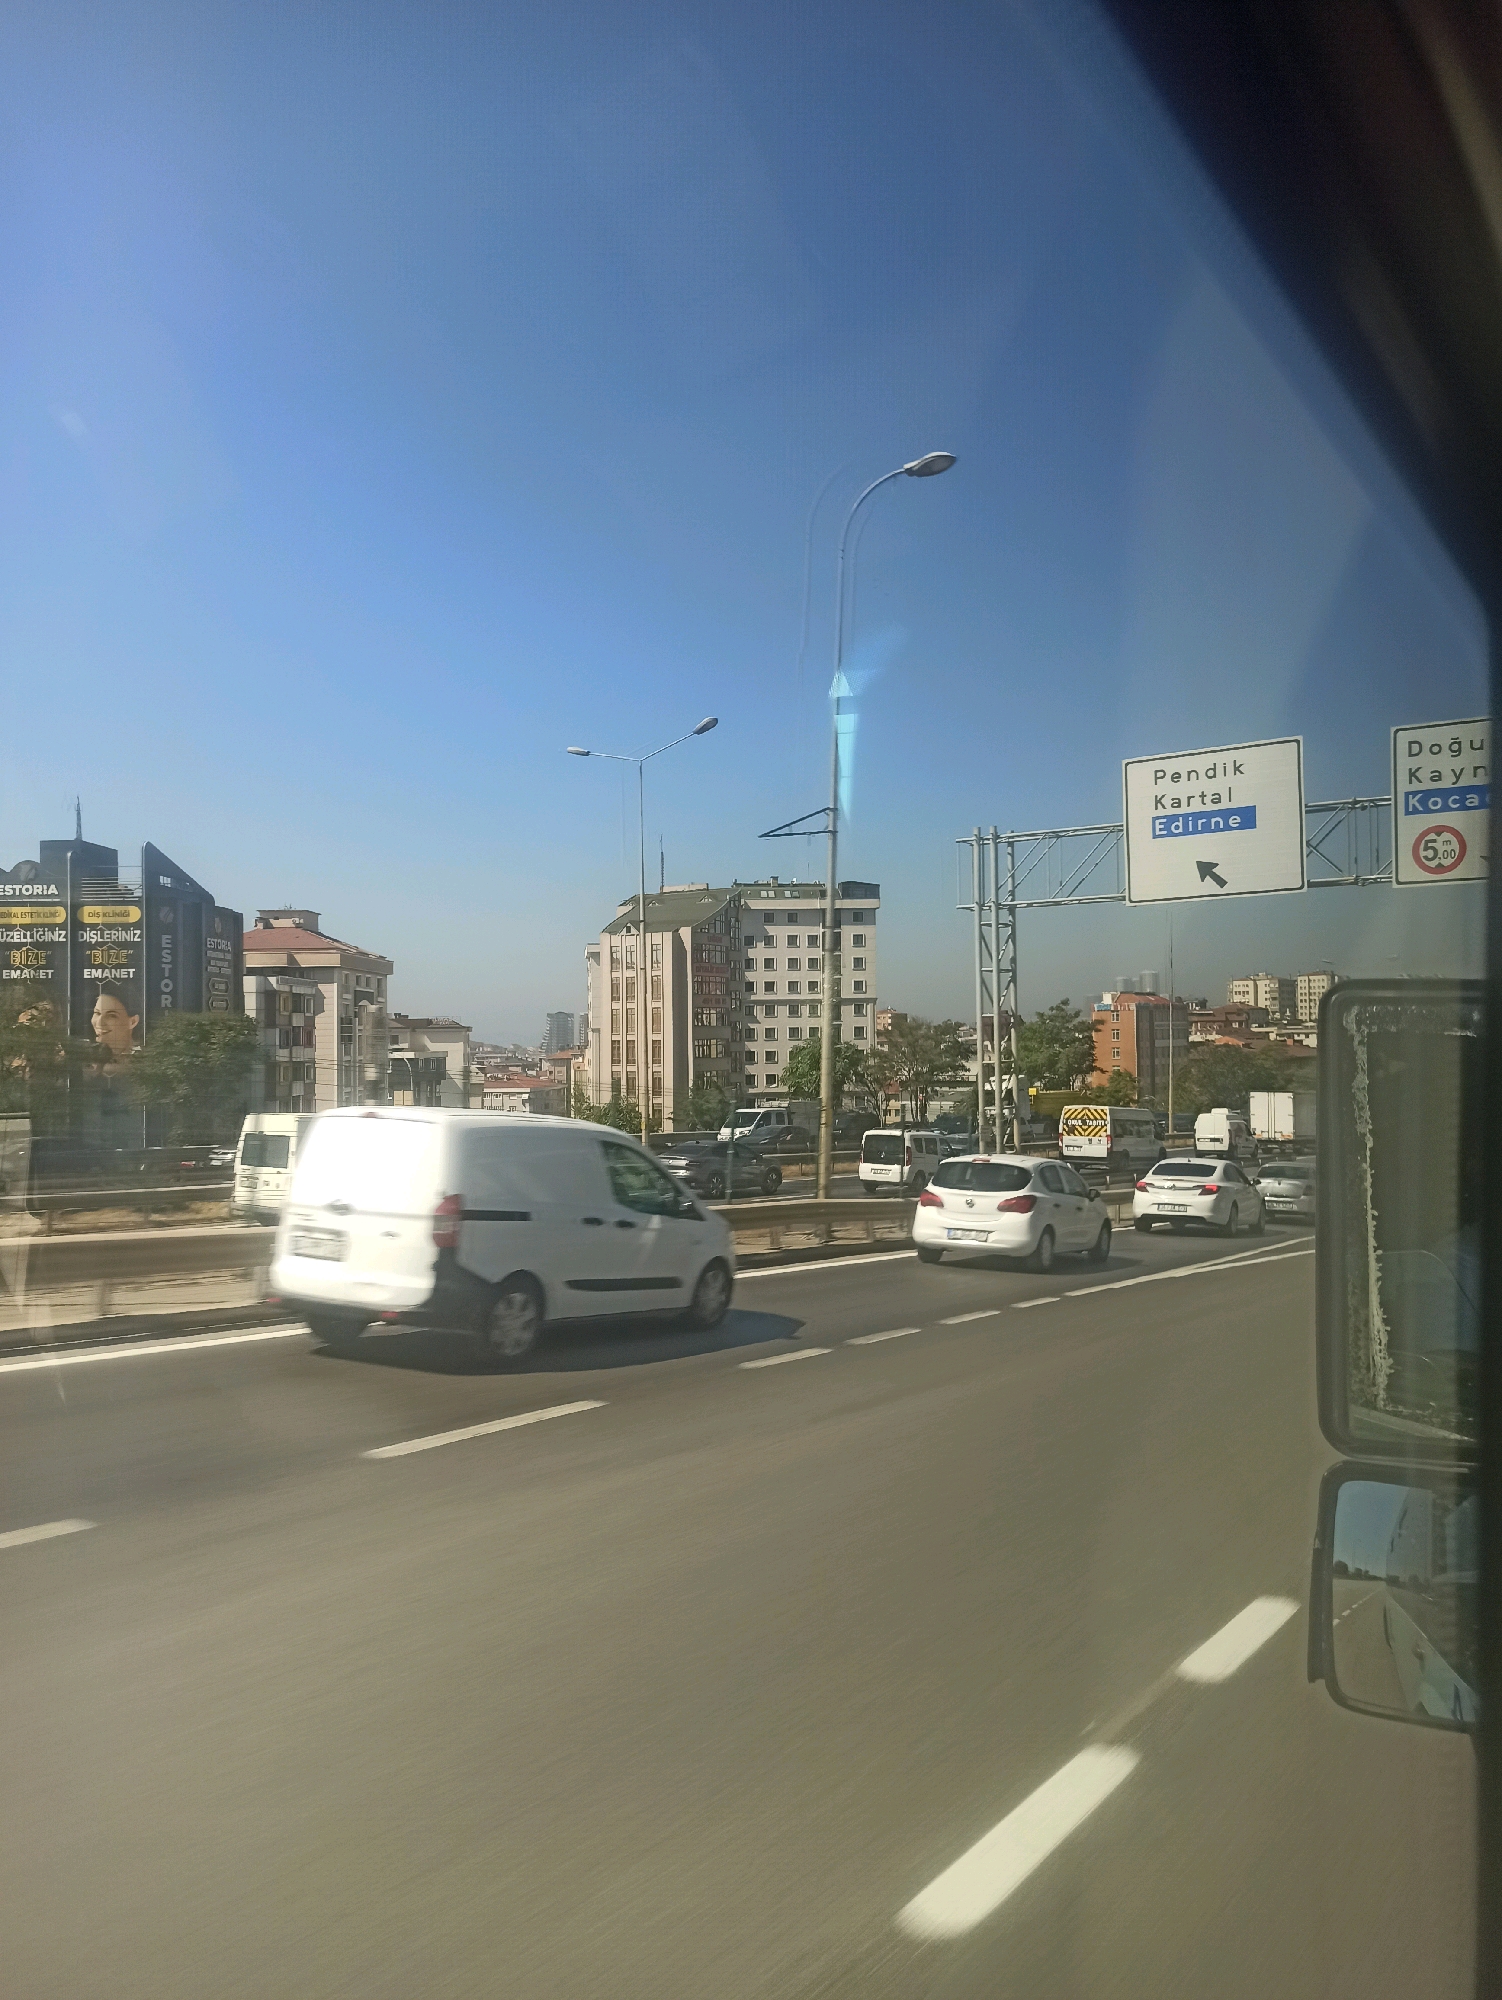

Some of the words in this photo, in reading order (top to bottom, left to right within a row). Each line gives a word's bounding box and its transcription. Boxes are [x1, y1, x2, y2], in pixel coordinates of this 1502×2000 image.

[1407, 737, 1485, 758] Doğu
[1153, 759, 1245, 786] Pendik
[1407, 765, 1488, 786] Kayn
[1154, 786, 1232, 811] Kartal
[1154, 815, 1242, 836] Edirne
[87, 909, 101, 919] DİŞ
[102, 909, 131, 918] KLİNİĞİ
[78, 926, 142, 945] DİŞLERİNİZ
[206, 937, 232, 951] ESTORIA
[2, 969, 55, 979] EMANET
[83, 968, 136, 979] EMANET
